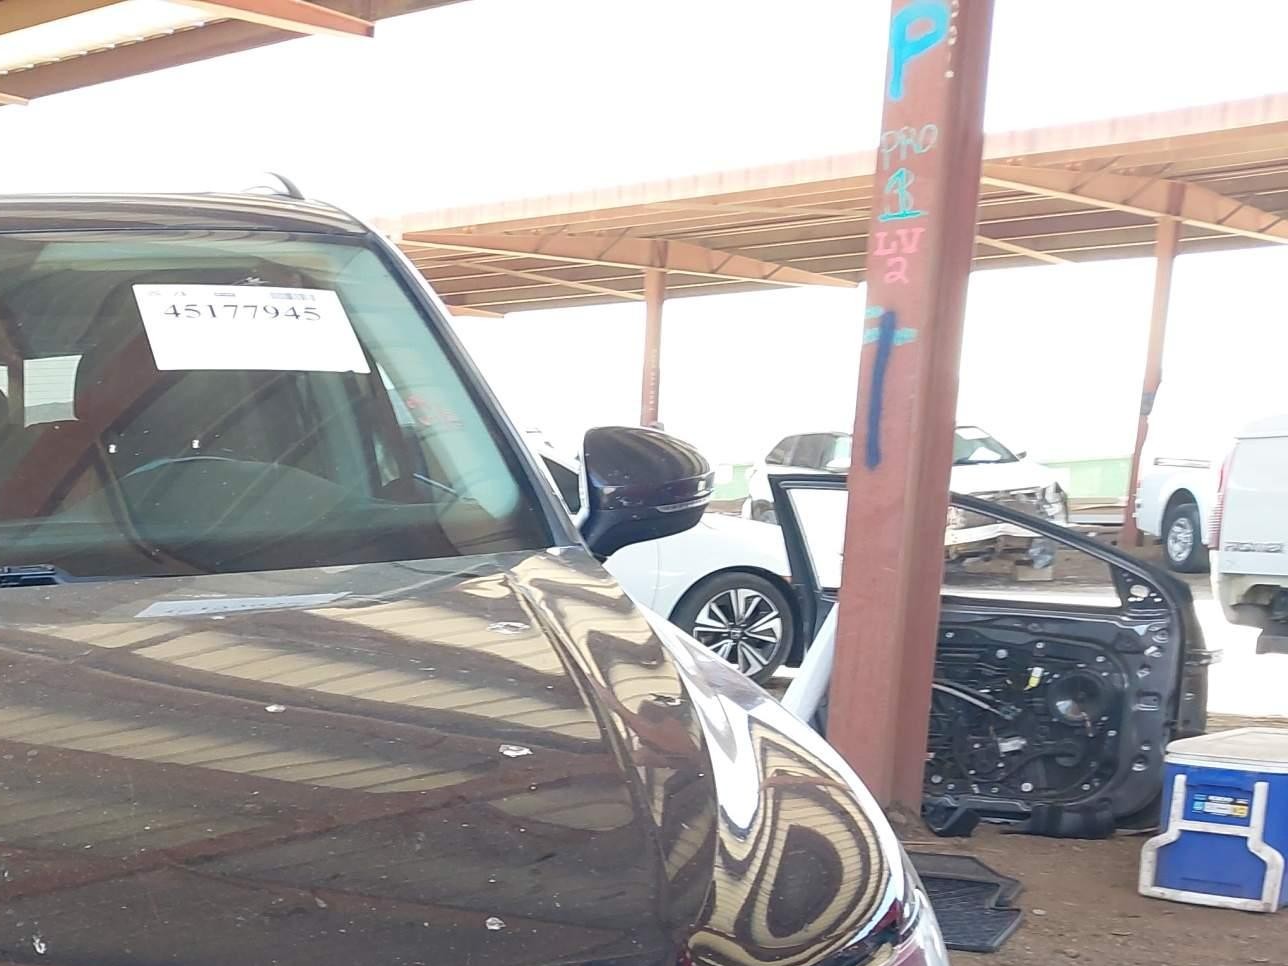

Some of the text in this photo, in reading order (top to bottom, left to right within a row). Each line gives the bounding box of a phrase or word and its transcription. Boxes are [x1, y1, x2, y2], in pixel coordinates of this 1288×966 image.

[889, 0, 950, 101] P
[883, 256, 910, 285] 2
[163, 303, 321, 321] 45177945
